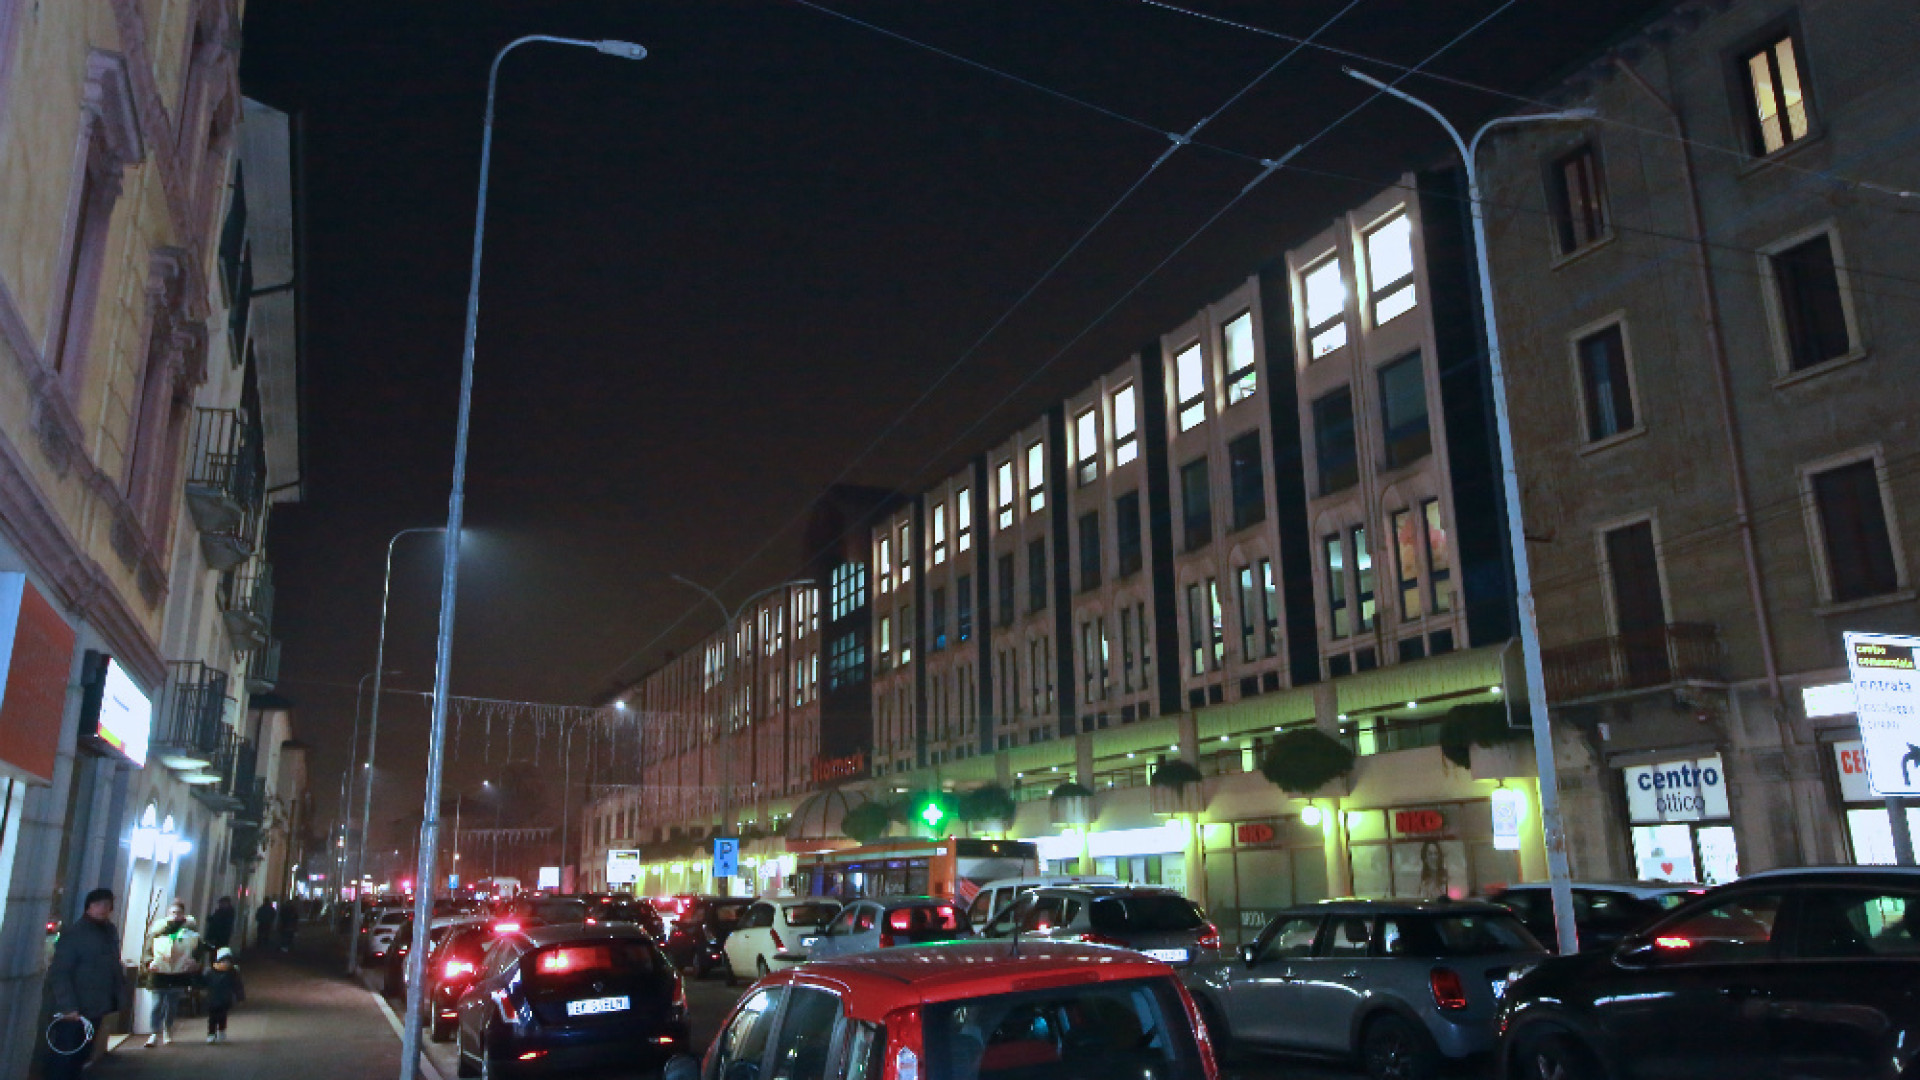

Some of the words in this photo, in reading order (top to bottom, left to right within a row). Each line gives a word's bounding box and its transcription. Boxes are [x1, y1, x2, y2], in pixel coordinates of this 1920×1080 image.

[1840, 749, 1867, 774] CE
[1638, 763, 1719, 791] centro
[1656, 791, 1706, 813] ottico
[1396, 810, 1443, 833] NKD
[719, 842, 732, 860] P
